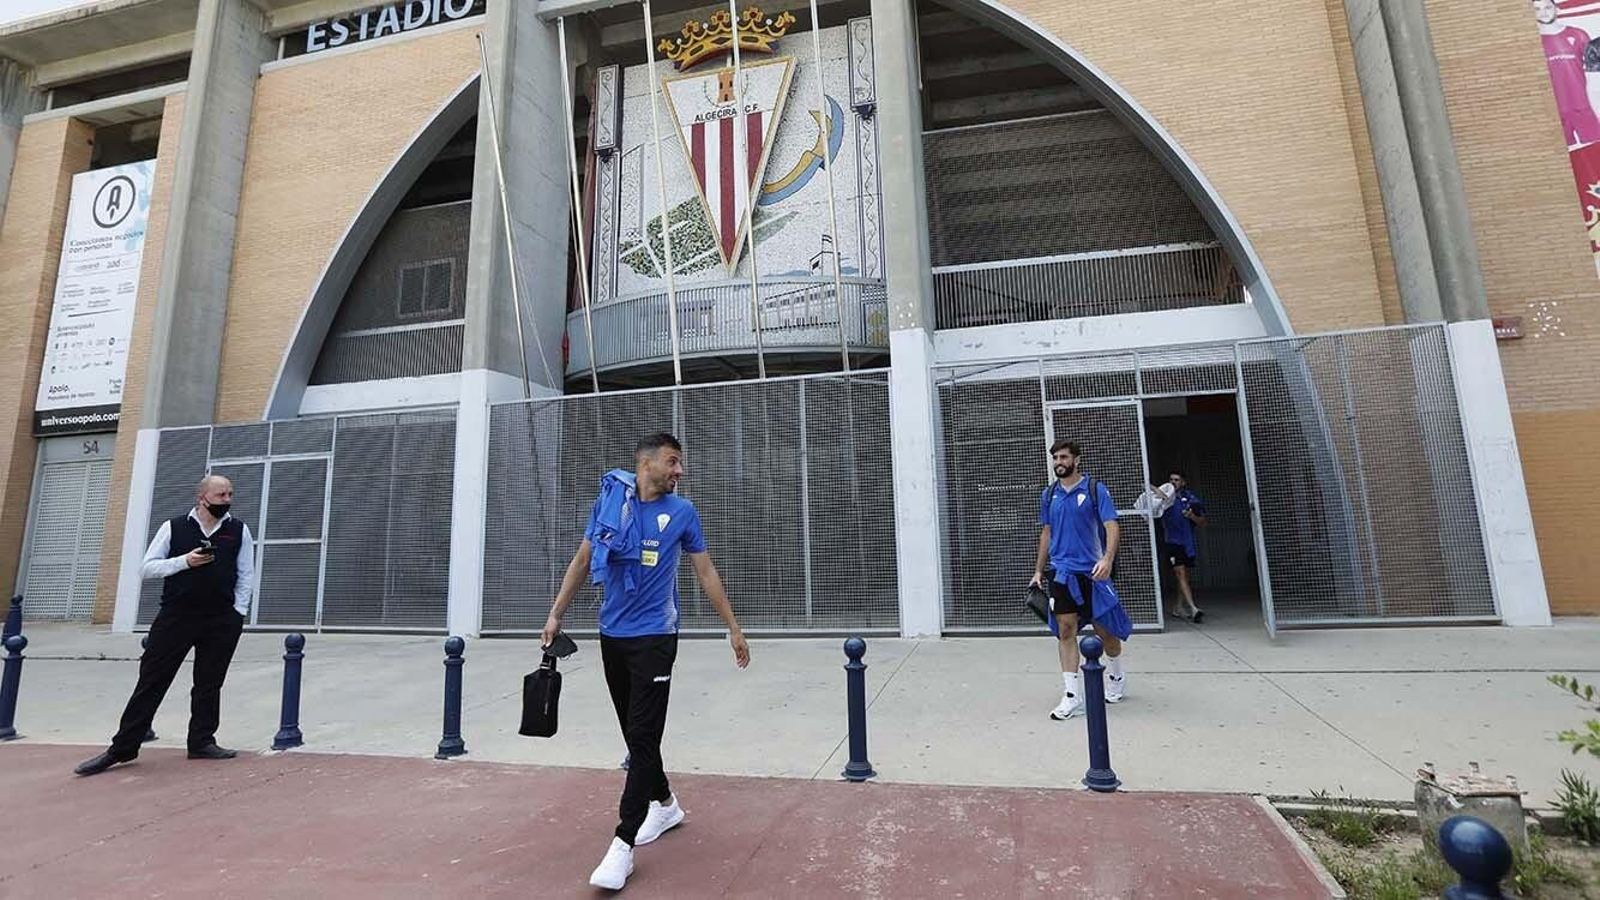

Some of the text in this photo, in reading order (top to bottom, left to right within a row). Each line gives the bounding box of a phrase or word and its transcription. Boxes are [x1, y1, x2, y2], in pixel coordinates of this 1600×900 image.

[307, 0, 474, 53] ESTADIO
[695, 108, 738, 122] ALGECIRA
[41, 413, 121, 427] universoapolo.com
[83, 441, 99, 454] 54
